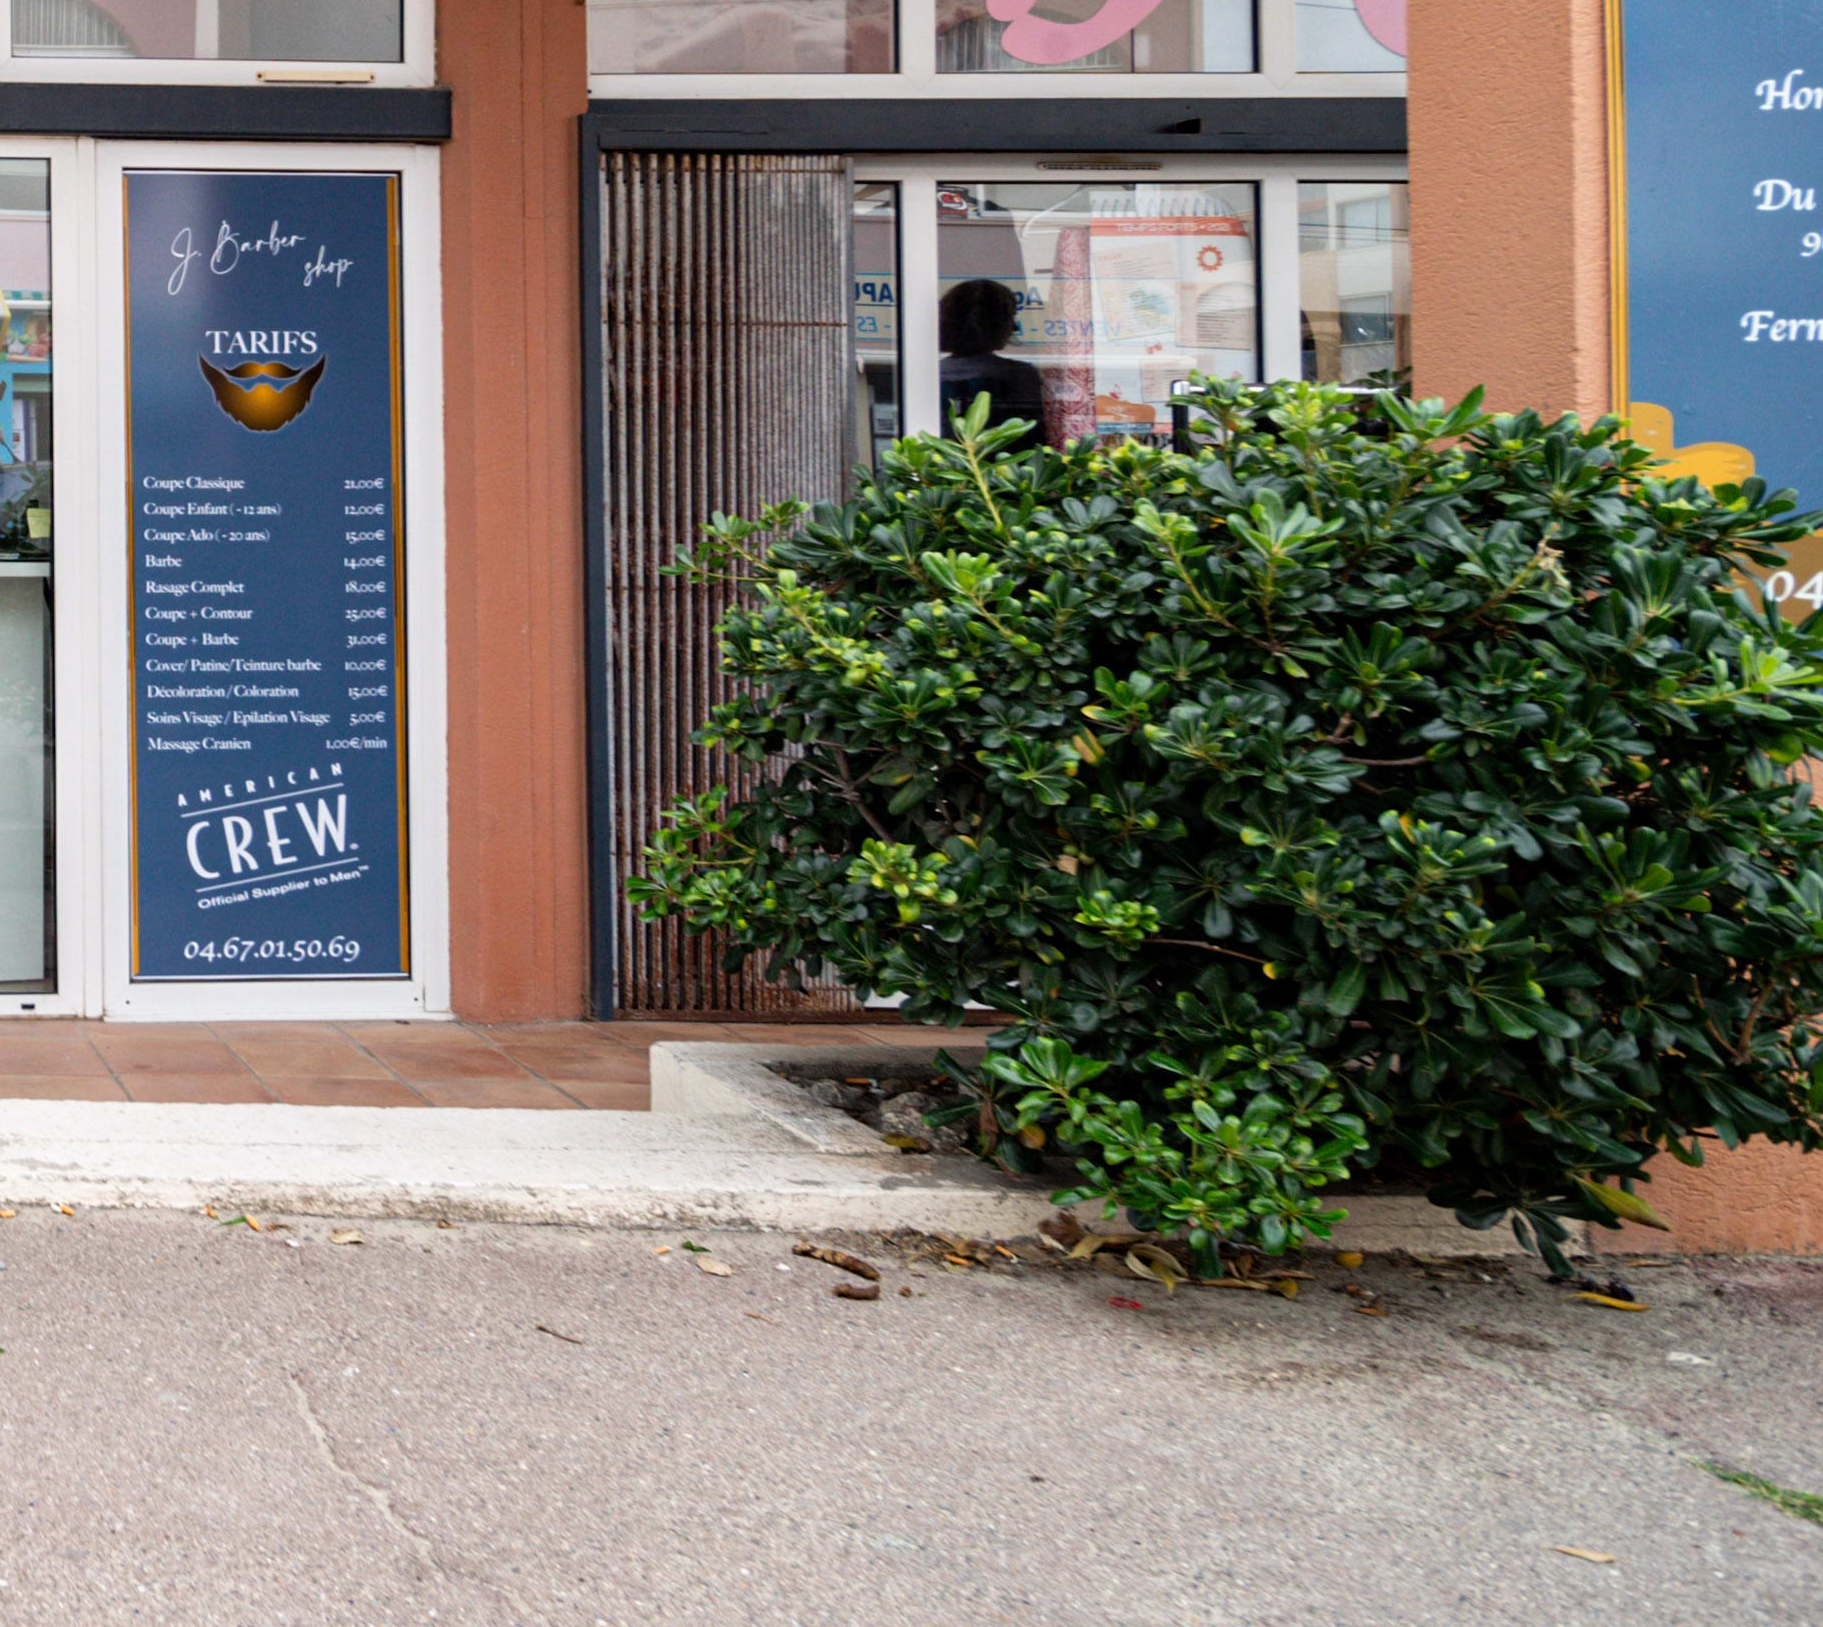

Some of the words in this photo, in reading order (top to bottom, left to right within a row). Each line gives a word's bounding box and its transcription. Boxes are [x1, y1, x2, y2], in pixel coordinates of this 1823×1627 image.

[1753, 178, 1817, 212] Du
[209, 219, 307, 276] Barber
[302, 244, 354, 289] shop
[205, 328, 319, 355] TARIFS
[143, 476, 185, 492] Coupe
[185, 476, 245, 492] Classique
[143, 502, 186, 518] Coupe
[187, 502, 228, 515] Enfant
[144, 528, 186, 545] Coupe
[189, 528, 214, 541] Ado
[145, 554, 183, 568] Barbe
[145, 580, 190, 597] Rasage
[190, 580, 244, 597] Complet
[144, 607, 187, 623] Coupe
[200, 607, 253, 620] Contour
[145, 633, 187, 649] Coupe
[202, 633, 239, 646] Barbe
[286, 658, 322, 671] barbe
[146, 711, 182, 724] Soins
[182, 710, 223, 727] Visage
[232, 710, 288, 727] Epilation
[289, 710, 330, 727] Visage
[147, 737, 201, 754] Massage
[201, 737, 251, 750] Cranien
[177, 762, 343, 807] AMERICAN
[197, 890, 250, 910] Official
[251, 879, 310, 899] Supplier
[313, 875, 329, 887] to
[184, 935, 361, 963] 04.67.01.50.69
